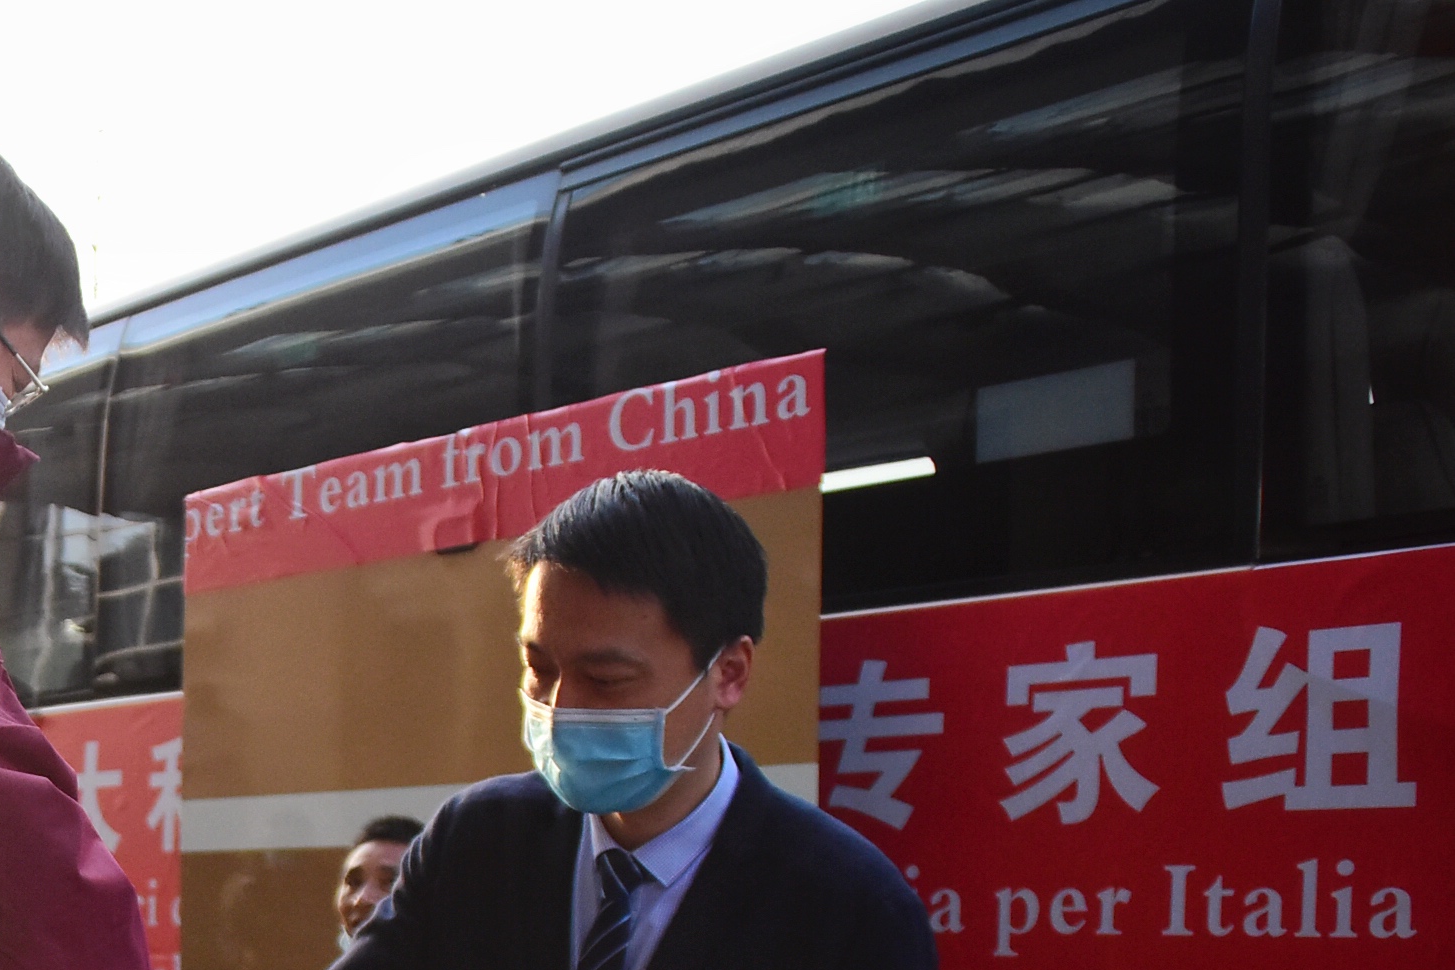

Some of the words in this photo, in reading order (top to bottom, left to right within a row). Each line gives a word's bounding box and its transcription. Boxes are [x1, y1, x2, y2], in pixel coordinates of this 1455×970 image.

[280, 456, 423, 520] Team
[441, 421, 585, 488] from
[608, 369, 811, 452] China
[818, 622, 1417, 830] 专家组
[993, 886, 1133, 957] per
[1162, 858, 1418, 939] Italia
